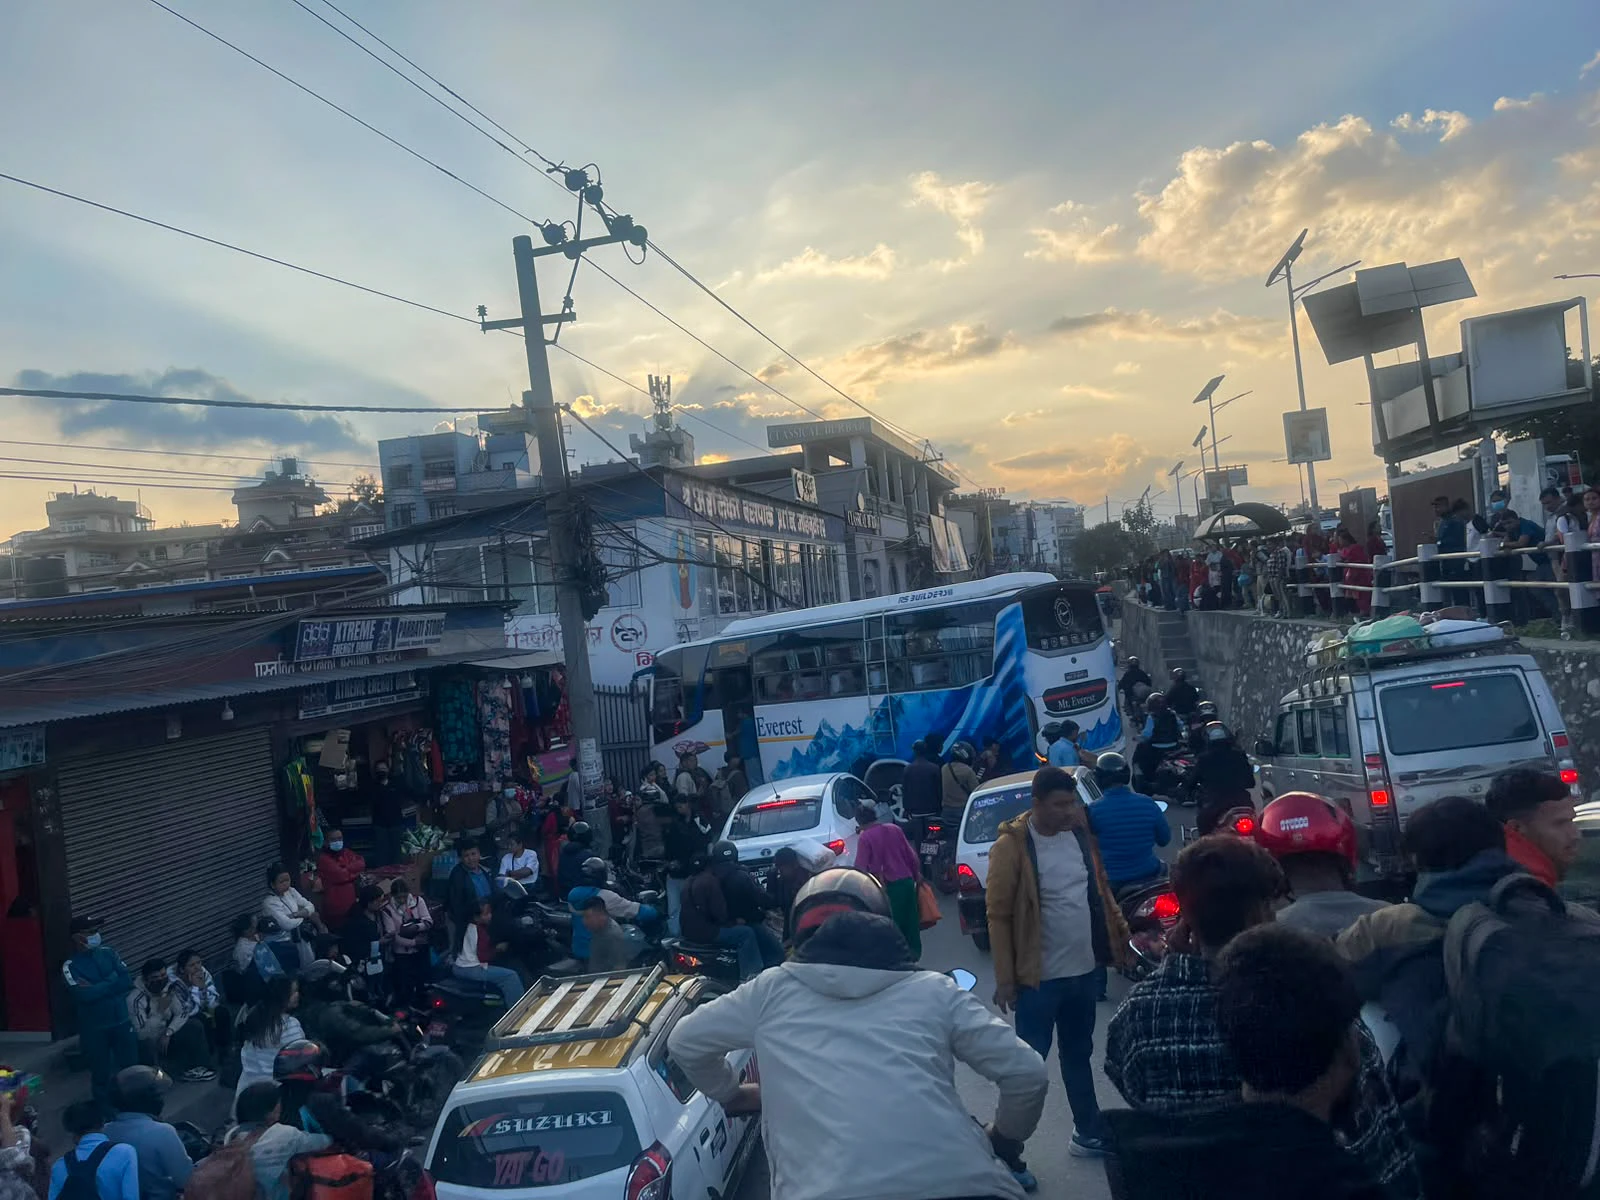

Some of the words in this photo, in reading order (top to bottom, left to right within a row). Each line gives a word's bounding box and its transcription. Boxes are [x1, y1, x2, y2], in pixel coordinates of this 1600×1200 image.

[768, 426, 822, 443] CLASSICAL
[334, 619, 377, 643] XTREME
[332, 640, 355, 656] ENERGY
[335, 679, 366, 700] XTREME
[1071, 693, 1096, 708] Everest
[755, 715, 804, 737] Everest
[493, 1110, 613, 1135] SUZUKI
